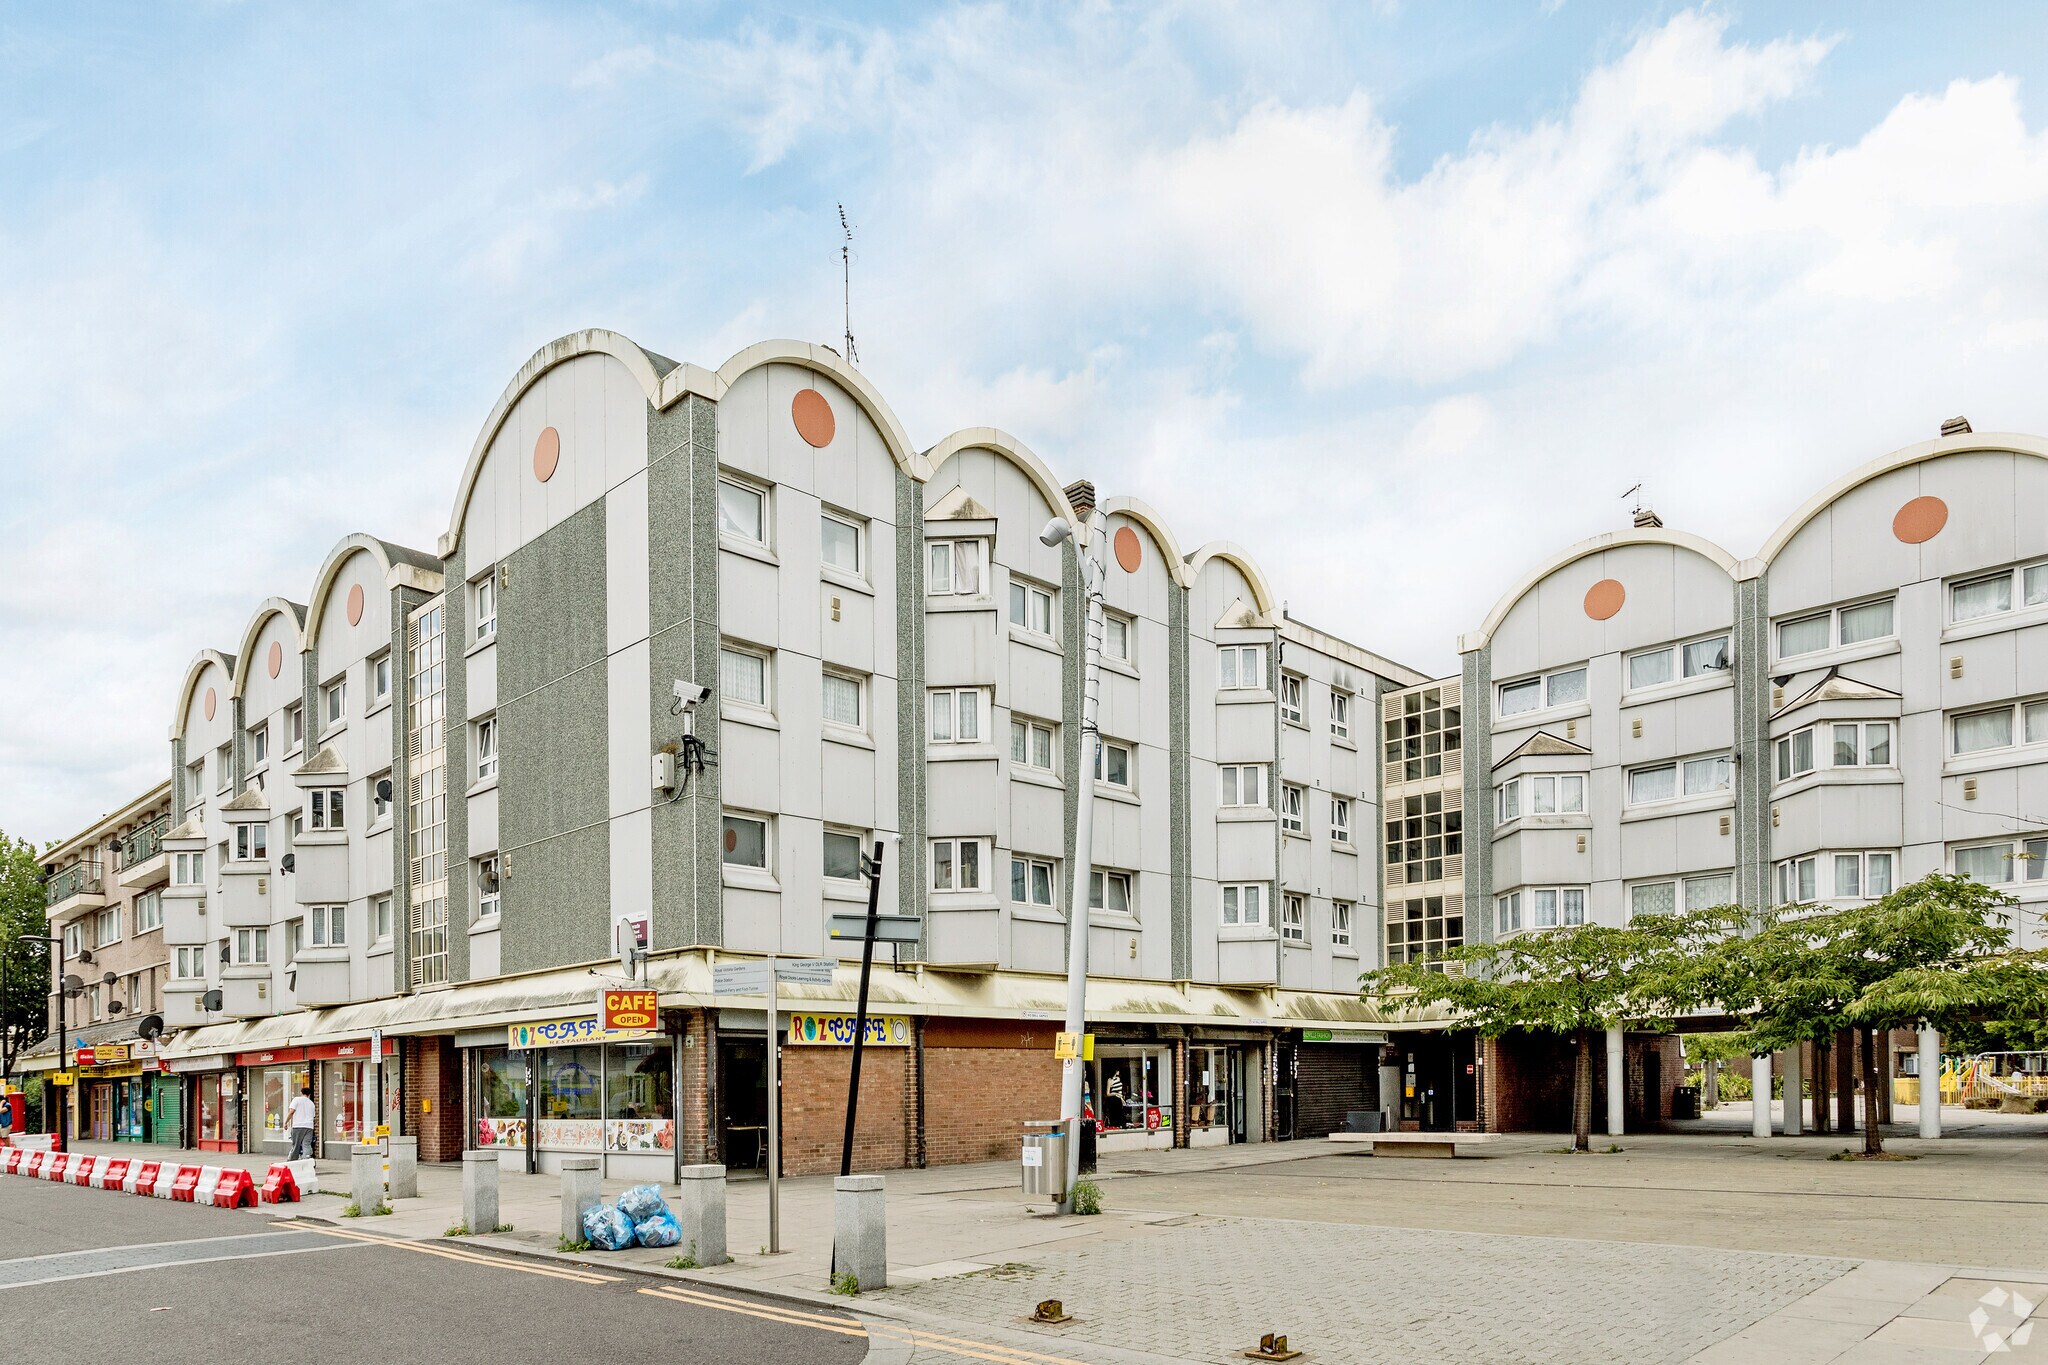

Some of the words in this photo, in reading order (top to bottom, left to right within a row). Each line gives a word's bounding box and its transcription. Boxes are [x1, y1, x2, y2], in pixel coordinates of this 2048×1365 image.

[606, 992, 656, 1011] CAFÉ
[620, 1016, 644, 1024] OPEN
[549, 1036, 607, 1045] RESTAURANT
